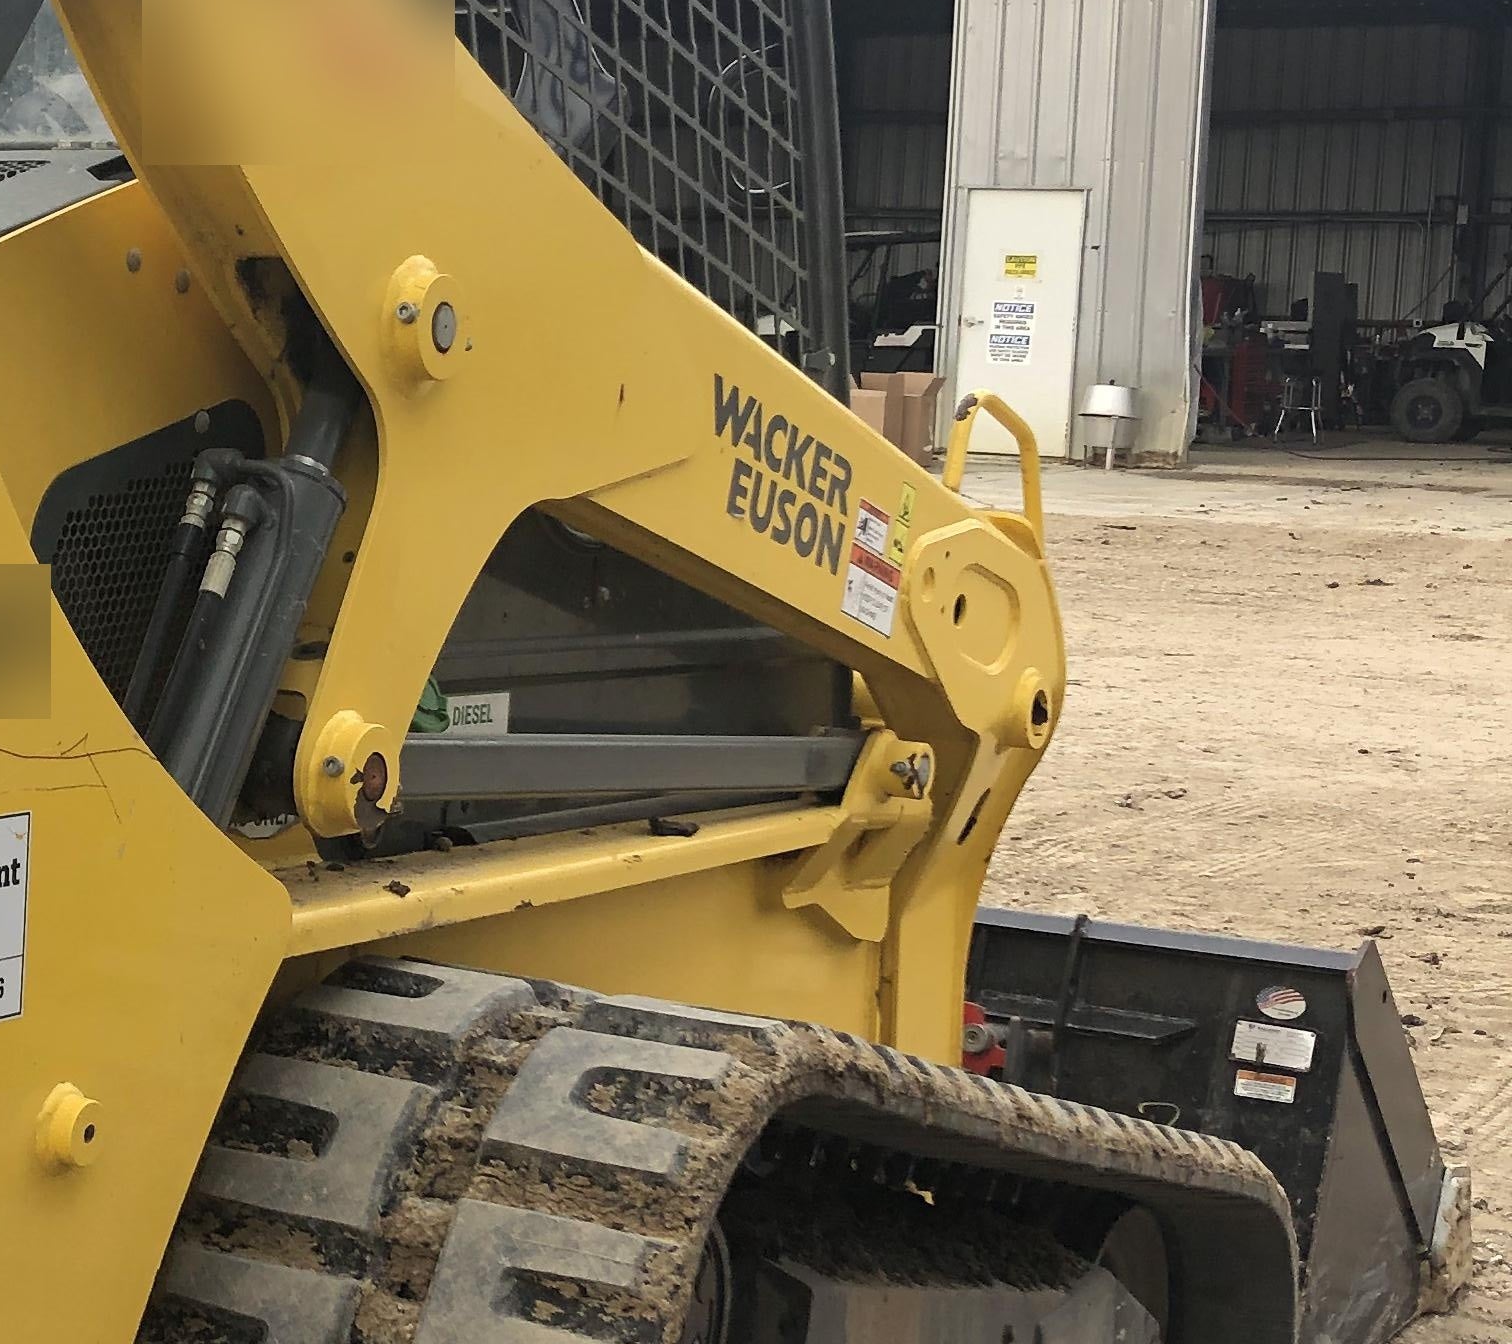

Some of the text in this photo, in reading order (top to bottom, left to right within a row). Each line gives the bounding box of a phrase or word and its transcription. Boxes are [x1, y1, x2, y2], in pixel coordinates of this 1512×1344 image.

[994, 303, 1033, 313] NOTICE
[990, 335, 1029, 344] NOTICE
[713, 372, 853, 516] WACKER
[452, 703, 494, 727] DIESEL
